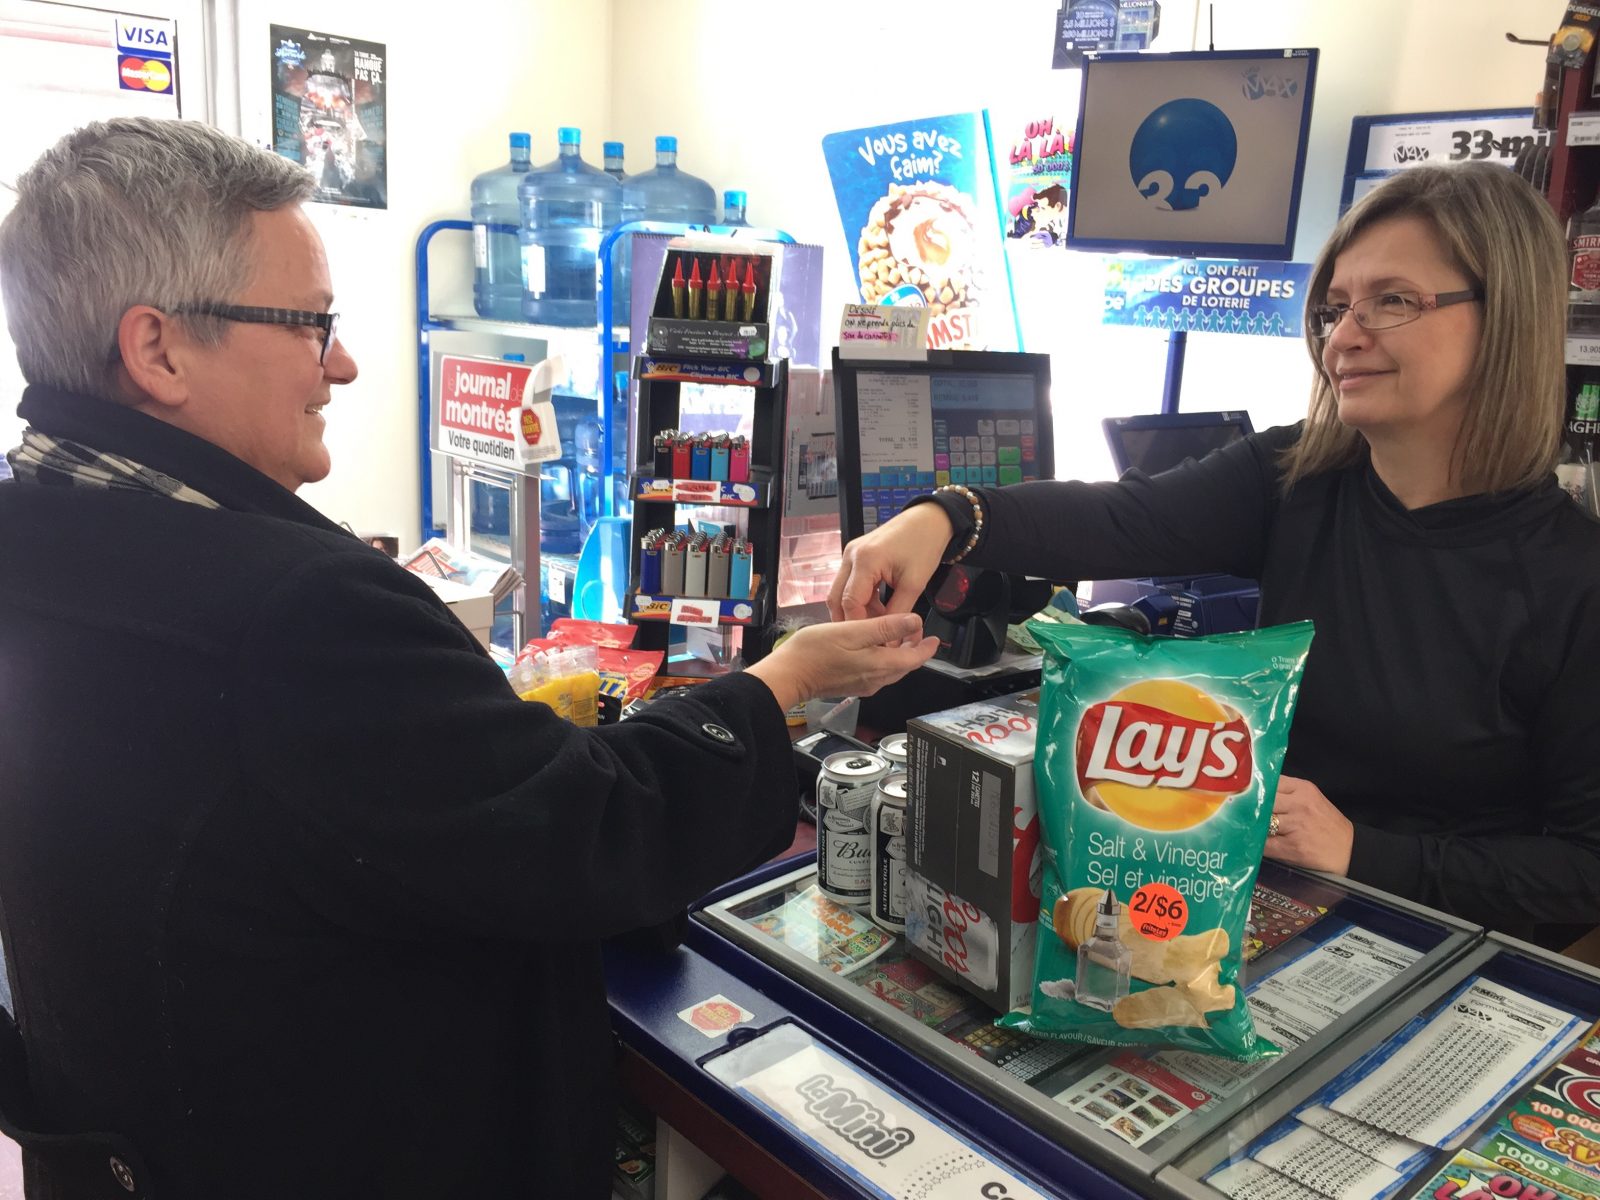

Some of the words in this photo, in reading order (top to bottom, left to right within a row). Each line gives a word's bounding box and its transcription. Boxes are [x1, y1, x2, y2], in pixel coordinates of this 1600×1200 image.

[124, 27, 168, 46] VISA
[355, 69, 369, 81] PAS
[1025, 116, 1054, 139] OH
[858, 132, 908, 166] Vous
[912, 130, 962, 158] avez
[1009, 138, 1032, 165] LÀ
[1039, 129, 1065, 159] LÀ
[1394, 145, 1429, 163] MAX
[1449, 130, 1494, 161] 33
[890, 151, 944, 180] faim?
[1206, 264, 1228, 276] ON
[1231, 265, 1259, 277] FAIT
[1143, 275, 1184, 293] DES
[1190, 277, 1295, 299] GROUPES
[1182, 295, 1198, 306] DE
[1201, 295, 1250, 309] LOTERIE
[454, 365, 512, 400] journal
[445, 400, 516, 435] montréa
[448, 430, 471, 450] Votre
[473, 440, 516, 460] quotidien
[646, 602, 668, 610] BIC
[1085, 705, 1245, 788] Lay's
[833, 840, 871, 859] Bu
[1088, 832, 1126, 860] Salt
[1132, 838, 1147, 861] &
[1154, 840, 1228, 873] Vinegar
[1087, 861, 1118, 886] Sel
[1124, 867, 1143, 888] et
[1150, 868, 1224, 902] vinaigre
[1133, 892, 1183, 920] 2/$6
[925, 883, 945, 966] LIGHT
[808, 1089, 911, 1157] Mini
[1531, 1101, 1564, 1119] 100
